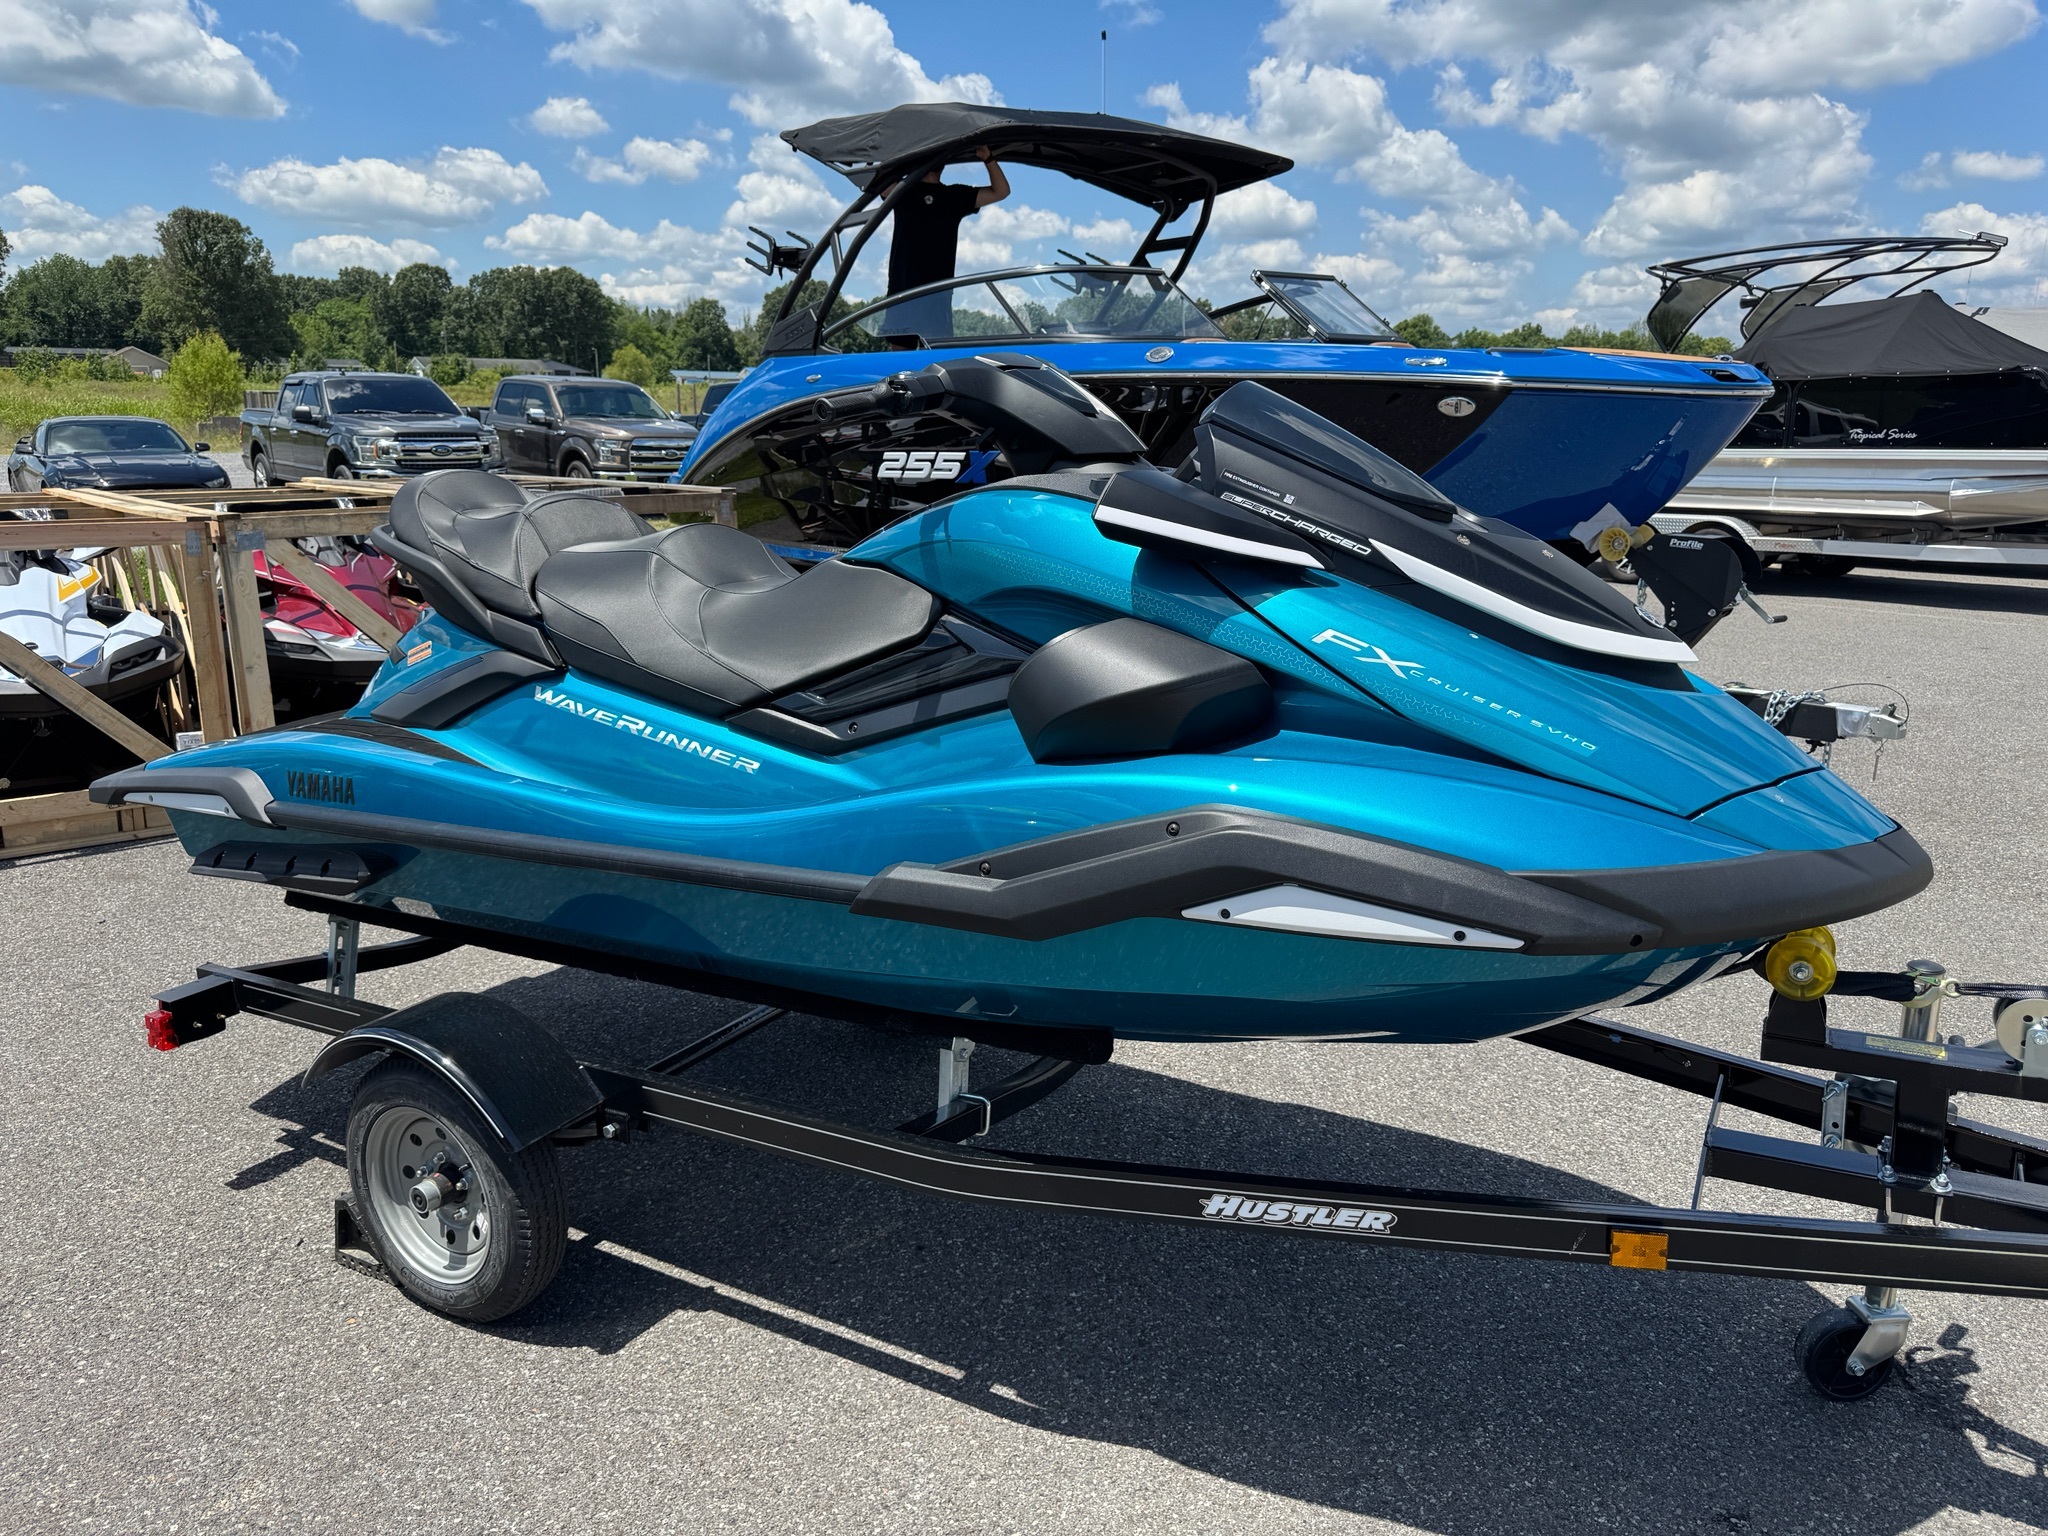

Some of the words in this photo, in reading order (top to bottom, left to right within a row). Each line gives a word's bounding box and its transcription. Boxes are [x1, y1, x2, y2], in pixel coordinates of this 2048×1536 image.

[1849, 428, 1887, 443] Tropical
[1887, 428, 1918, 440] Series
[877, 450, 1001, 484] 255X
[1220, 492, 1372, 555] SUPERCHARGED
[1670, 538, 1704, 549] Profile
[1311, 628, 1426, 680] FX
[1409, 669, 1522, 718] CRUISER
[1529, 719, 1597, 751] SVHO
[286, 770, 356, 806] YAMAHA
[1199, 1194, 1398, 1234] HUSTLER
